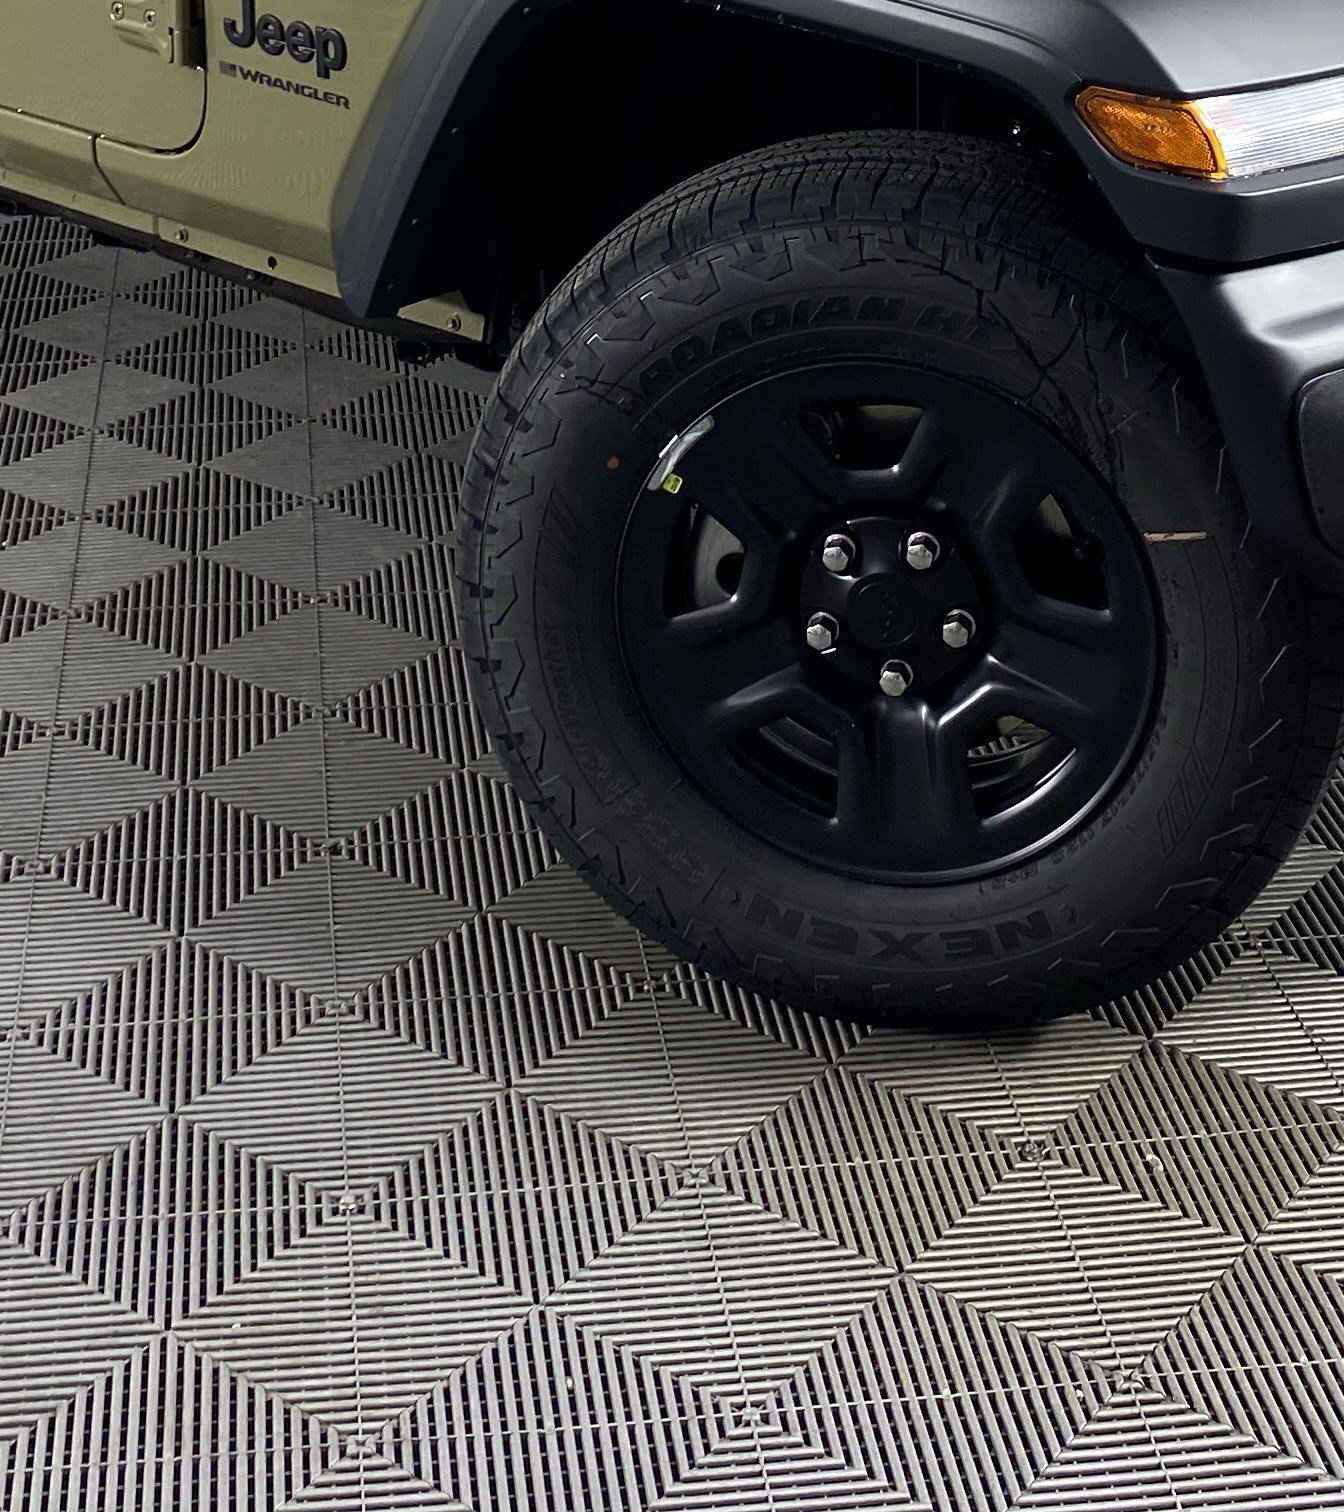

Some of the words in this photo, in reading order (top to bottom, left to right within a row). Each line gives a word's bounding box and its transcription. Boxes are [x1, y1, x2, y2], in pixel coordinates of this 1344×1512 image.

[238, 65, 350, 110] WRANGLER
[639, 294, 907, 390] ROADIAN
[744, 893, 1054, 962] NEXEN
